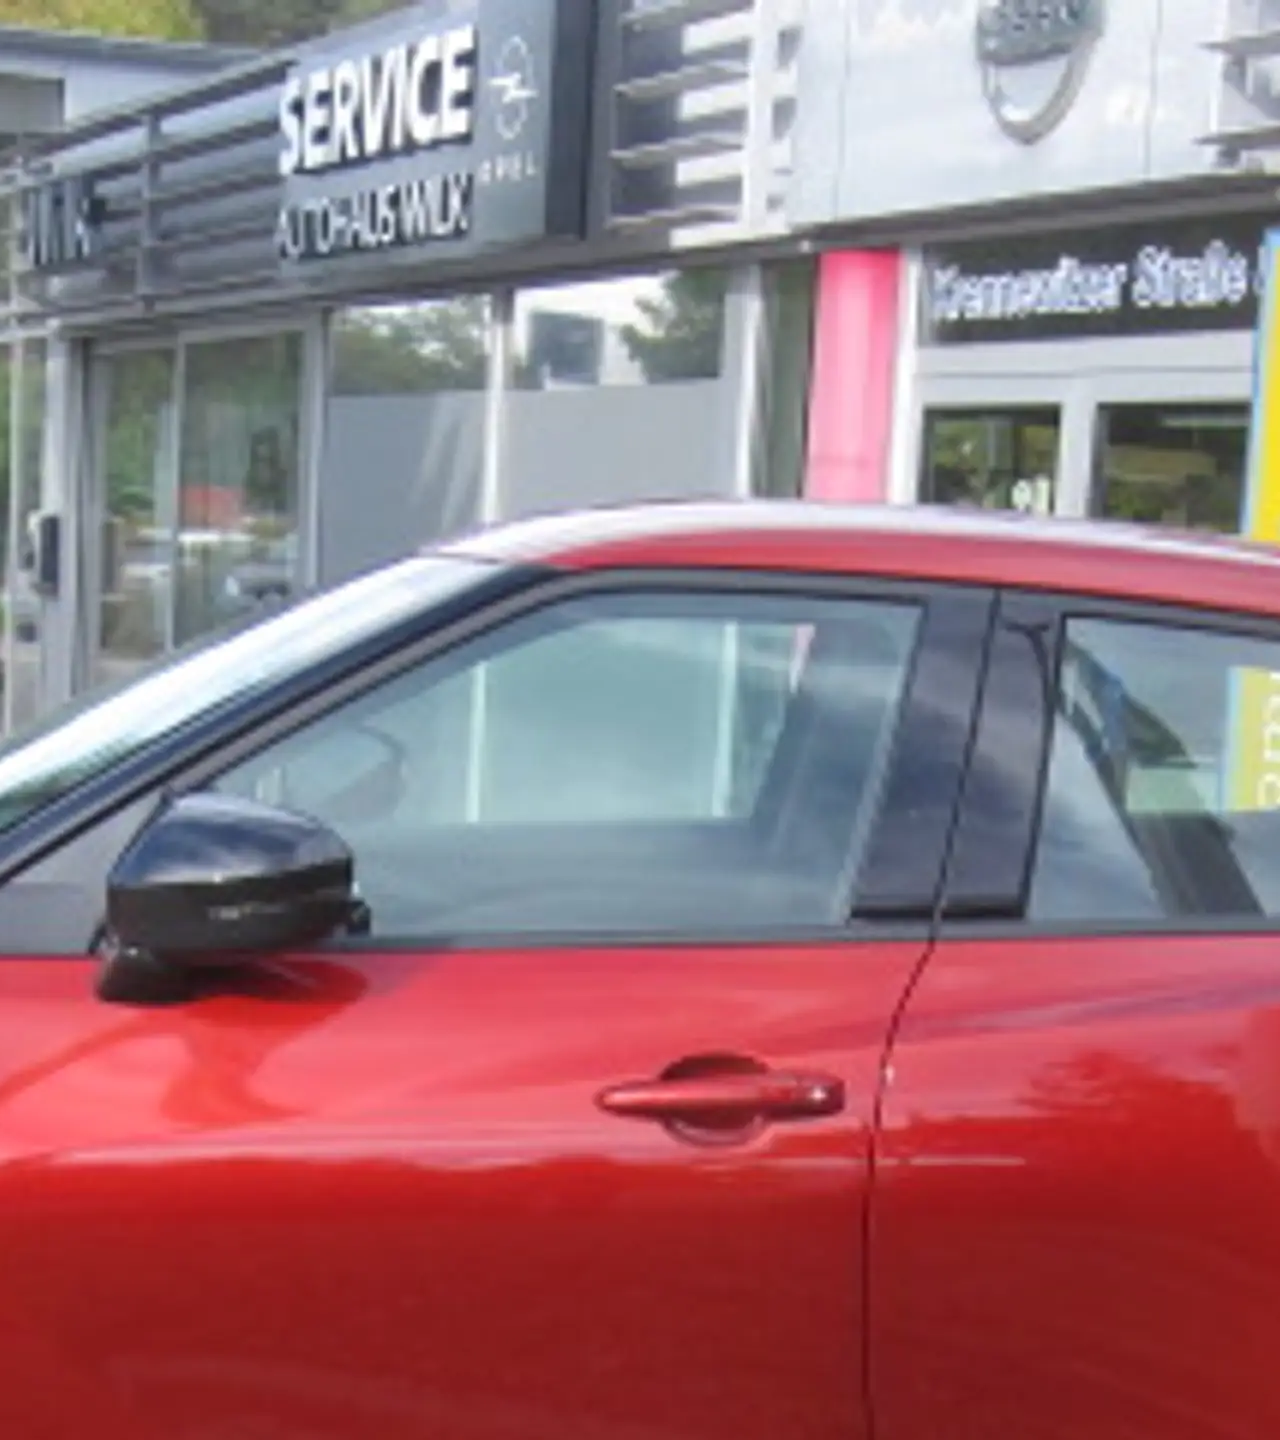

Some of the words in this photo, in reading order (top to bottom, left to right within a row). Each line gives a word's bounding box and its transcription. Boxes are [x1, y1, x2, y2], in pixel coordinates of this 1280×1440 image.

[278, 23, 474, 177] SERVICE
[275, 183, 397, 261] AUTOHAUS
[1131, 237, 1248, 310] Straße
